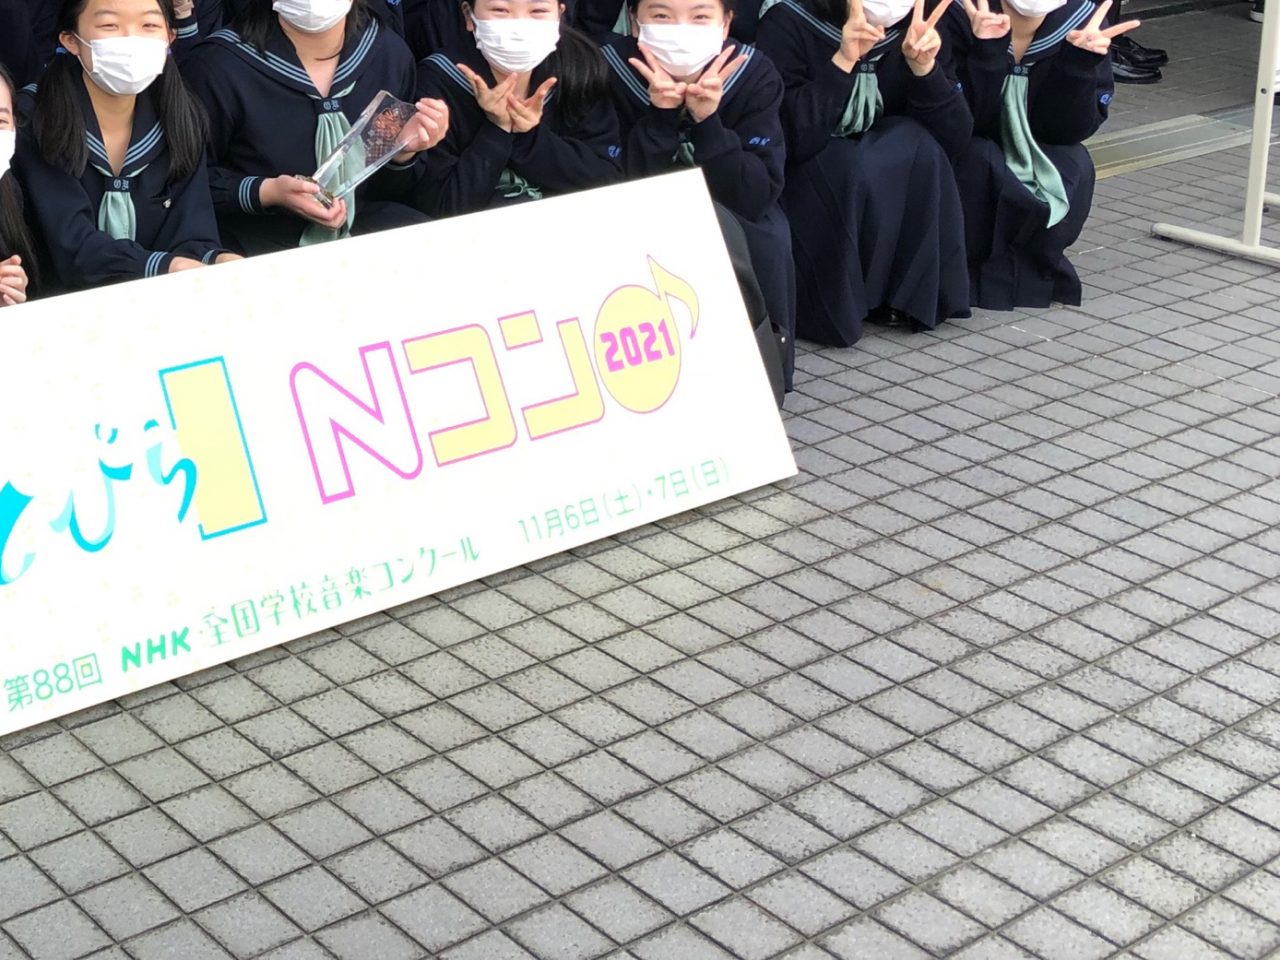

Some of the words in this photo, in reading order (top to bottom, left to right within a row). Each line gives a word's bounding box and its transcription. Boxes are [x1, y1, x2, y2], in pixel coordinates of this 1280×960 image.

[600, 318, 676, 373] 2021
[3, 652, 103, 713] 第88回
[121, 626, 192, 672] NHK
[201, 536, 480, 648] 全国学校音楽コンクール
